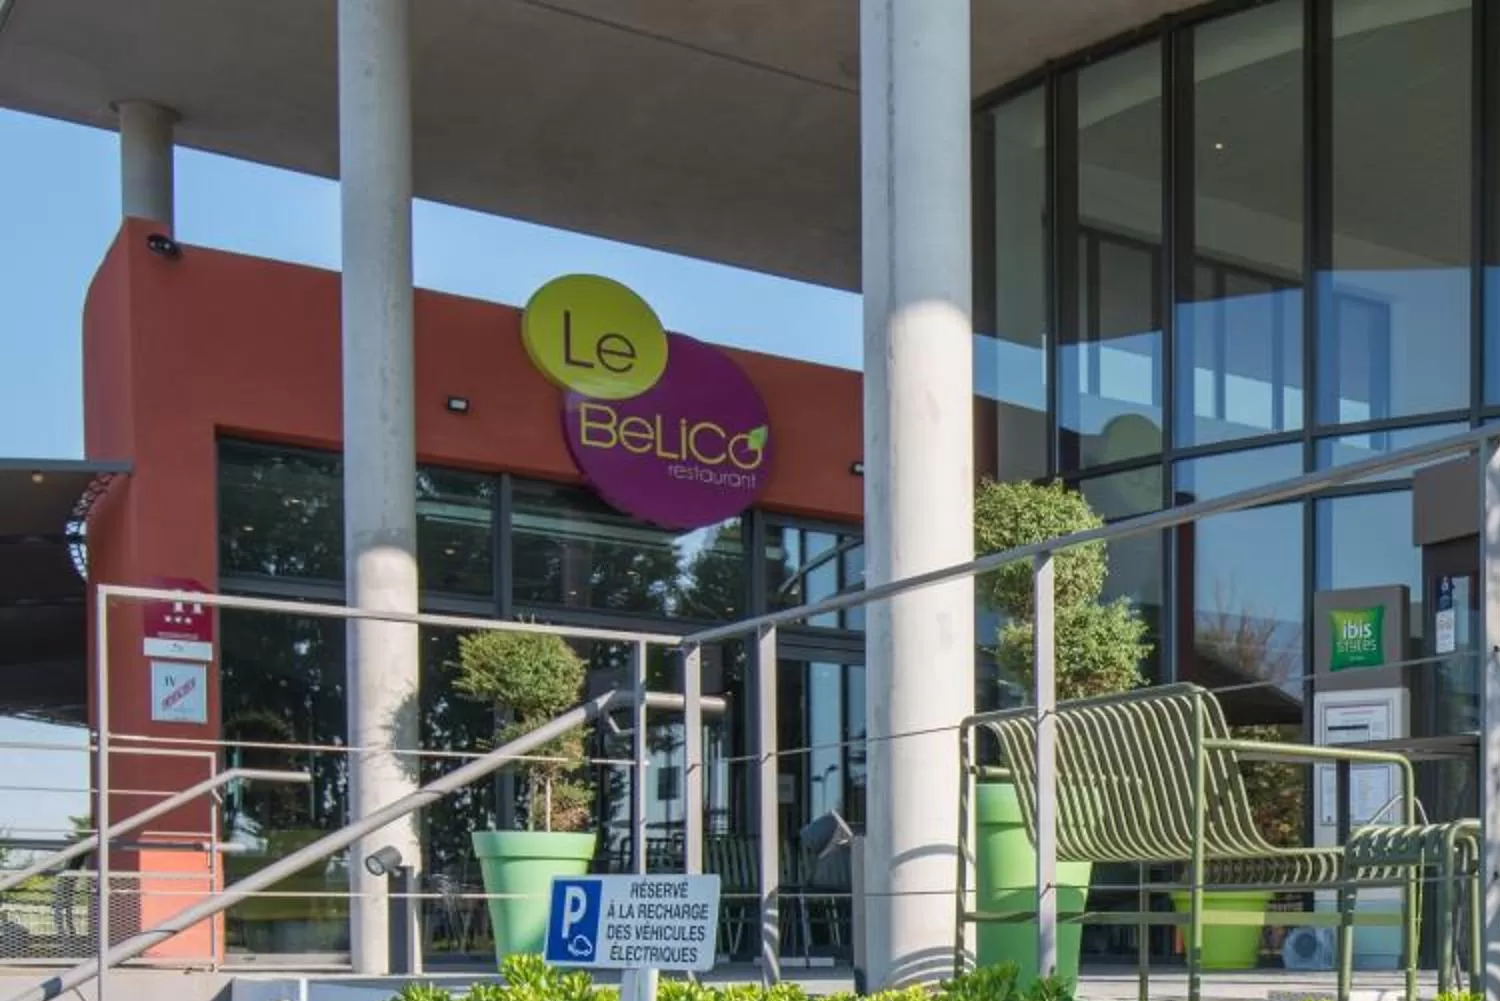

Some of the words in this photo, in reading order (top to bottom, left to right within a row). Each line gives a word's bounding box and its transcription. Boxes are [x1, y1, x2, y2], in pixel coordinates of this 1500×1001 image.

[563, 309, 637, 373] Le
[667, 463, 756, 489] restaurant
[1343, 619, 1373, 639] ibis
[562, 885, 588, 939] P
[619, 903, 635, 919] LA
[637, 903, 709, 920] RECHARGE
[607, 924, 631, 940] DES
[635, 920, 705, 942] VÉHICULES
[610, 941, 698, 963] ÉLECTRIQUES
